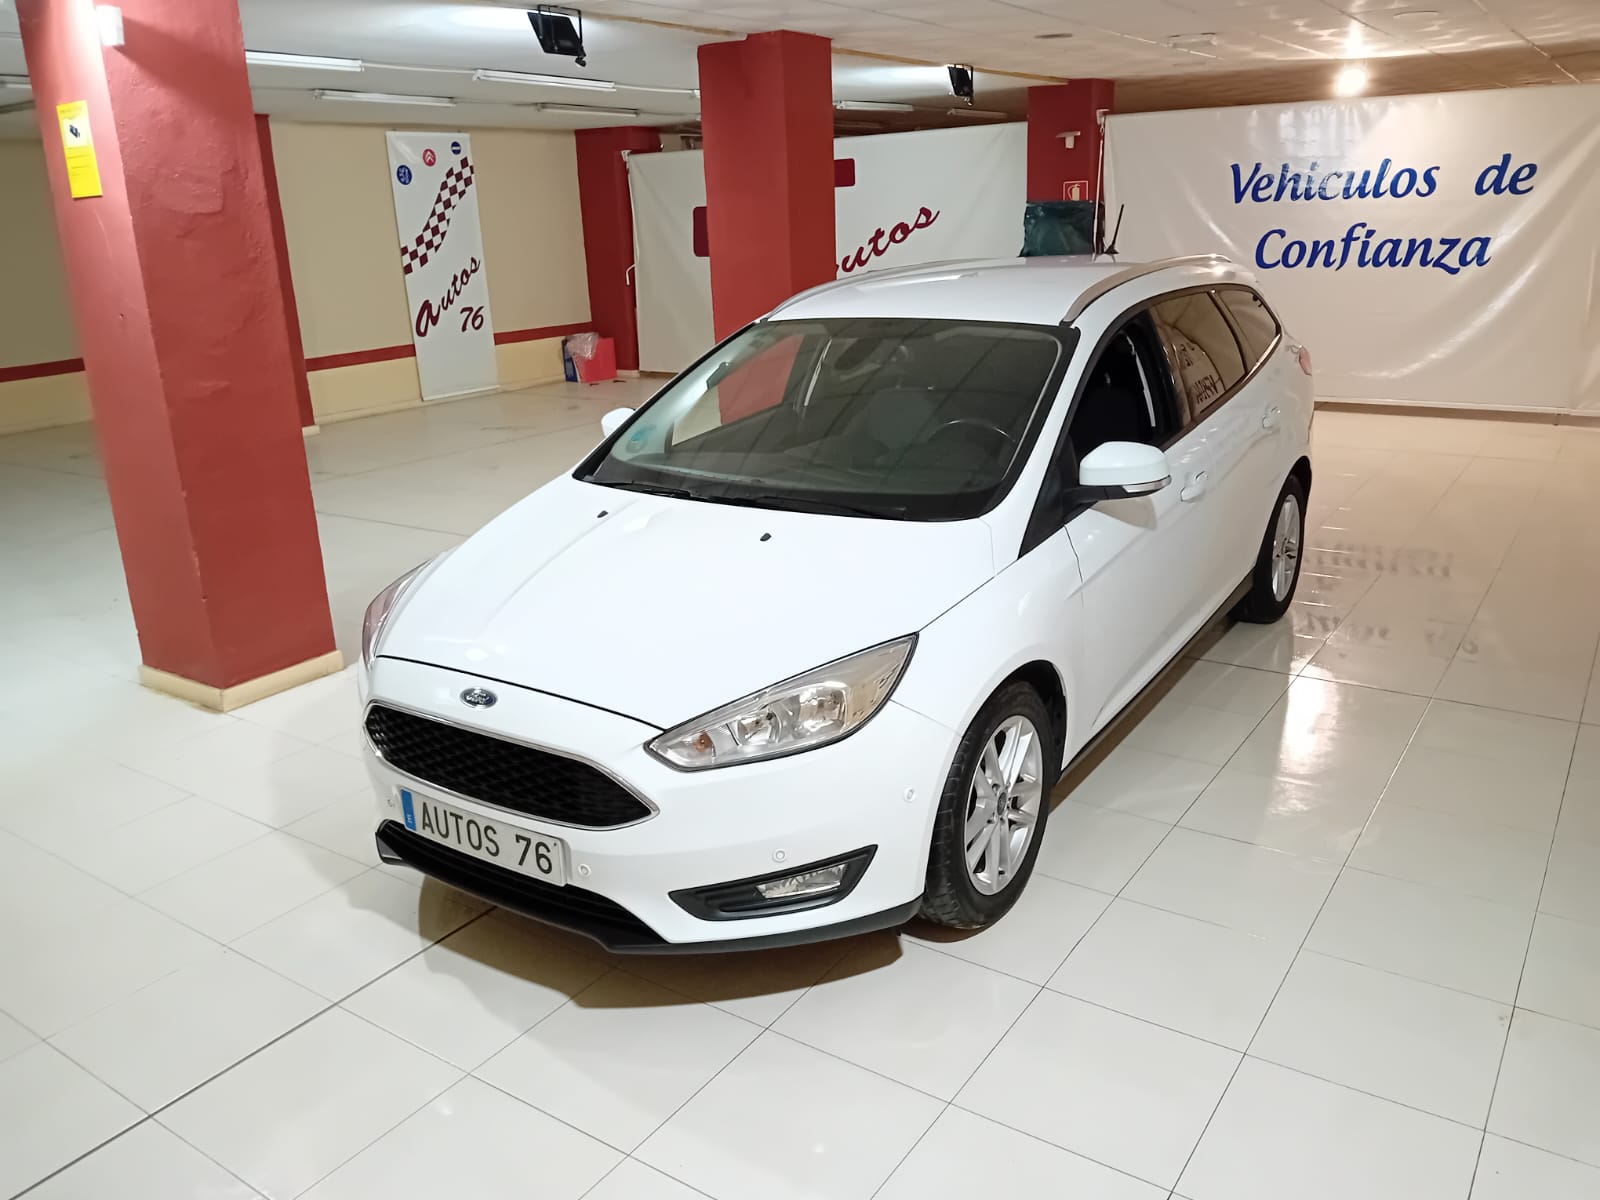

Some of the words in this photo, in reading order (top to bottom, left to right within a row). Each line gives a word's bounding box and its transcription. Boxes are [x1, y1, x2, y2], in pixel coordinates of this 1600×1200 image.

[1474, 153, 1538, 196] de
[836, 206, 940, 273] utos
[1255, 222, 1493, 275] Confianza
[460, 305, 485, 332] 76
[422, 802, 500, 857] AUTOS
[515, 834, 553, 874] 76
